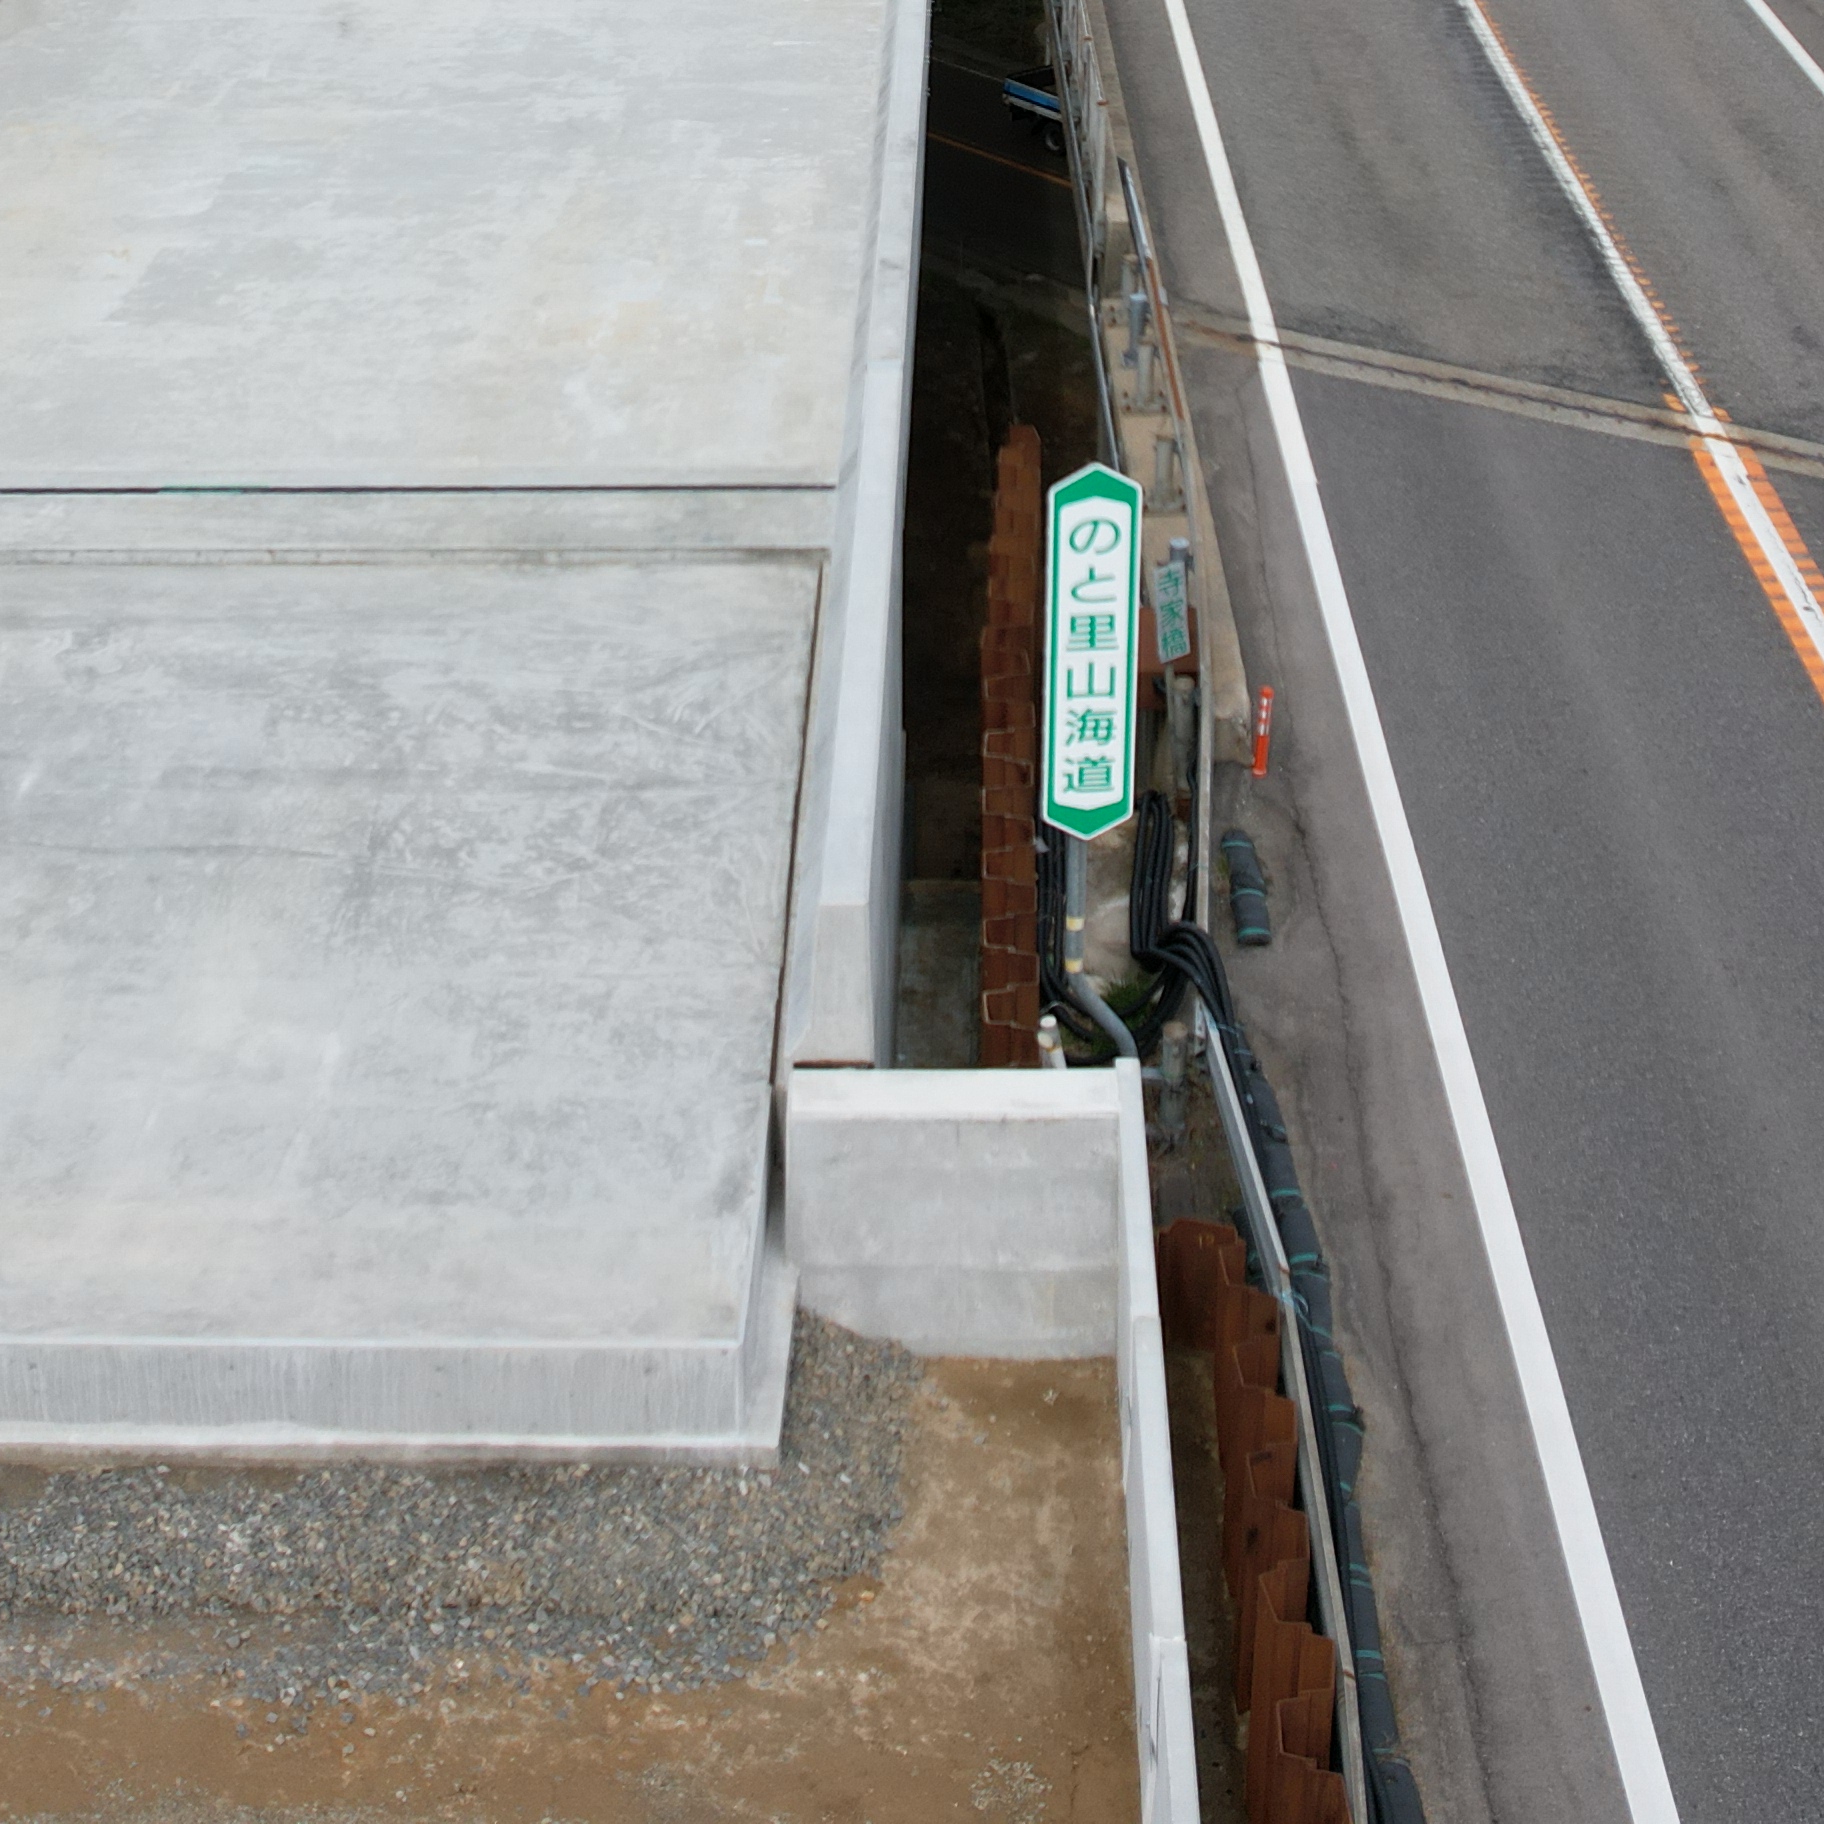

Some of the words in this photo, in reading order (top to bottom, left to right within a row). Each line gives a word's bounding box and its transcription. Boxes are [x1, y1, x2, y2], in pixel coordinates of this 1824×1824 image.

[1062, 517, 1122, 794] のと里山海道
